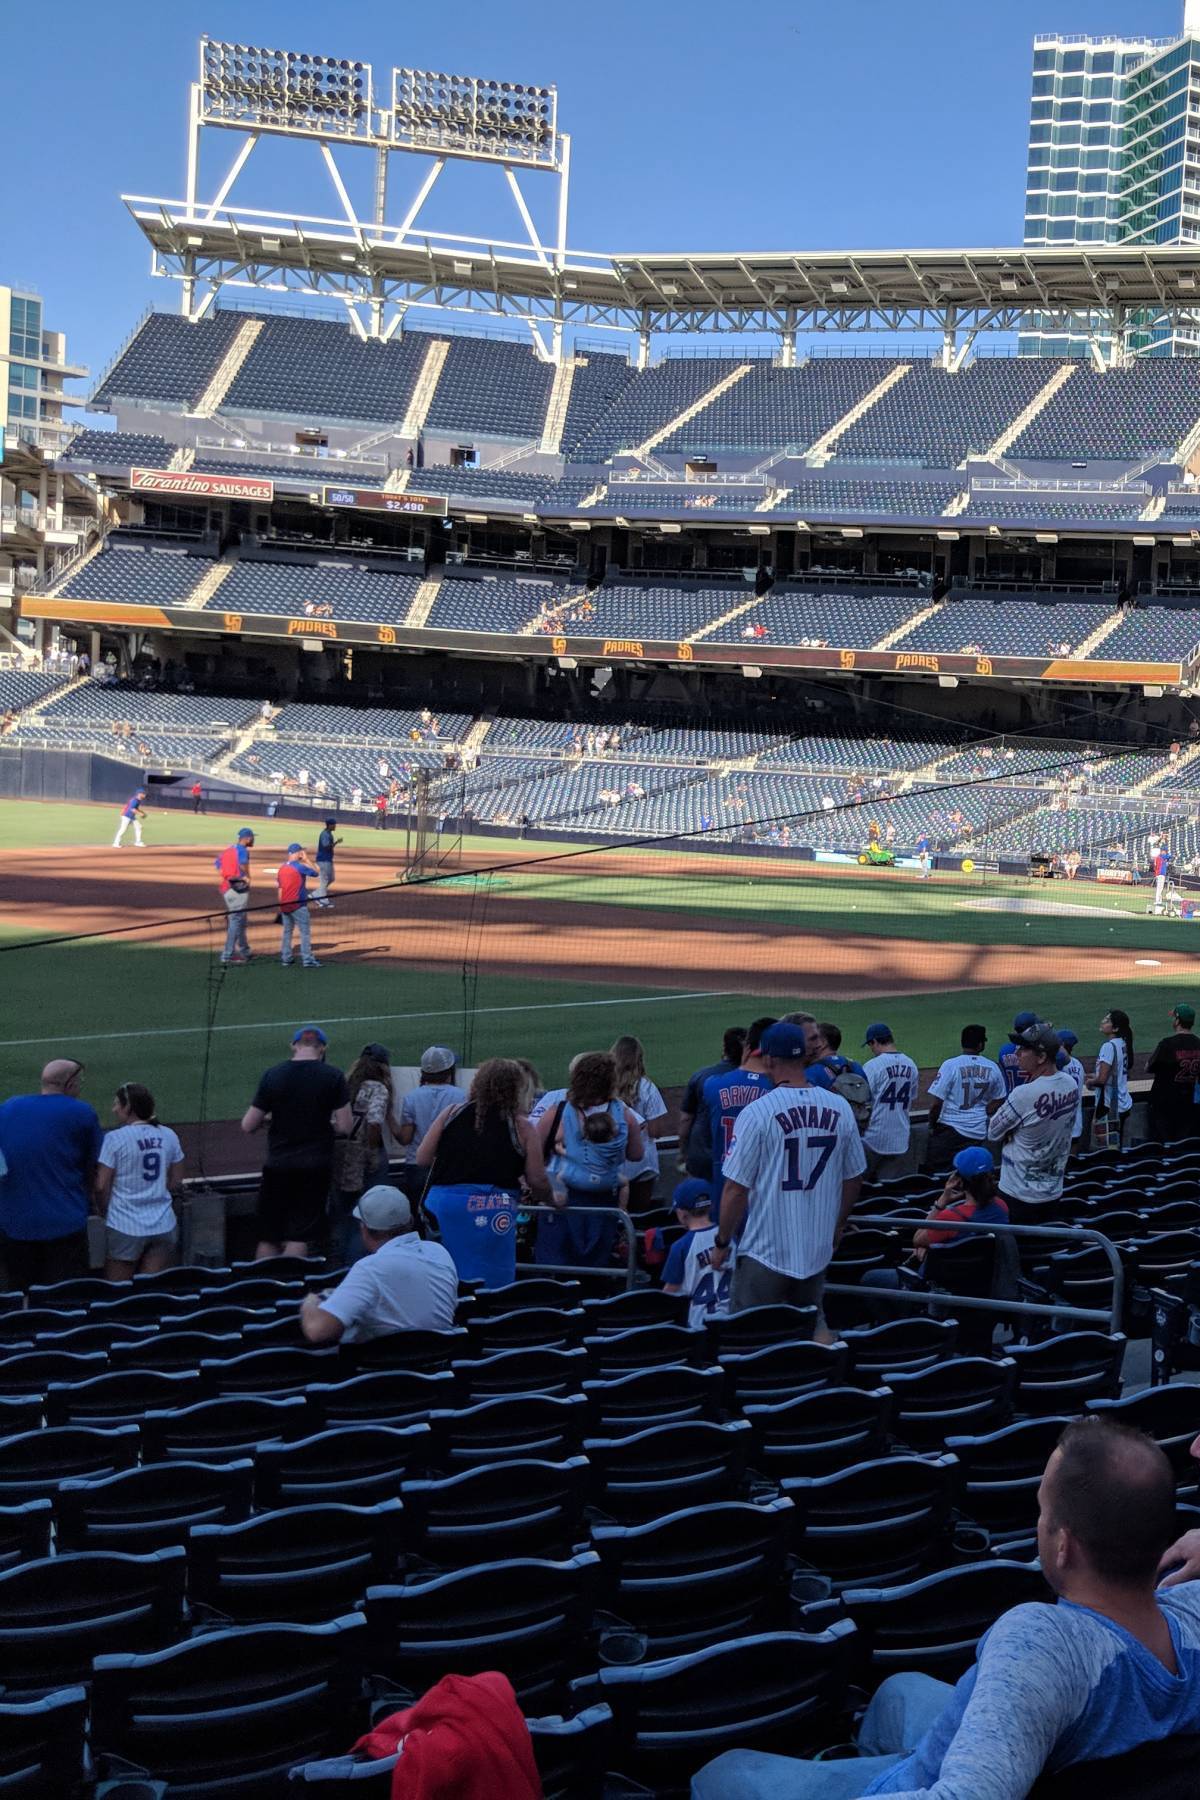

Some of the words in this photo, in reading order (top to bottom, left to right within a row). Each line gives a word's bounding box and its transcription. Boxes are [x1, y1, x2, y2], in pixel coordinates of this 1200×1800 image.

[134, 471, 210, 492] Tarantino
[211, 482, 270, 498] SAUSAGES
[331, 493, 354, 504] 50/50
[287, 620, 338, 638] PADRES
[603, 640, 644, 657] PADRES
[895, 654, 939, 672] PADRES
[886, 1064, 912, 1080] RIZZO
[960, 1064, 993, 1080] BRYANT
[719, 1085, 769, 1109] BRYA
[880, 1081, 911, 1112] 44
[960, 1081, 990, 1111] 17
[775, 1105, 841, 1135] BRYANT
[137, 1138, 163, 1151] BAEZ
[143, 1152, 160, 1181] 9
[782, 1135, 838, 1191] 17
